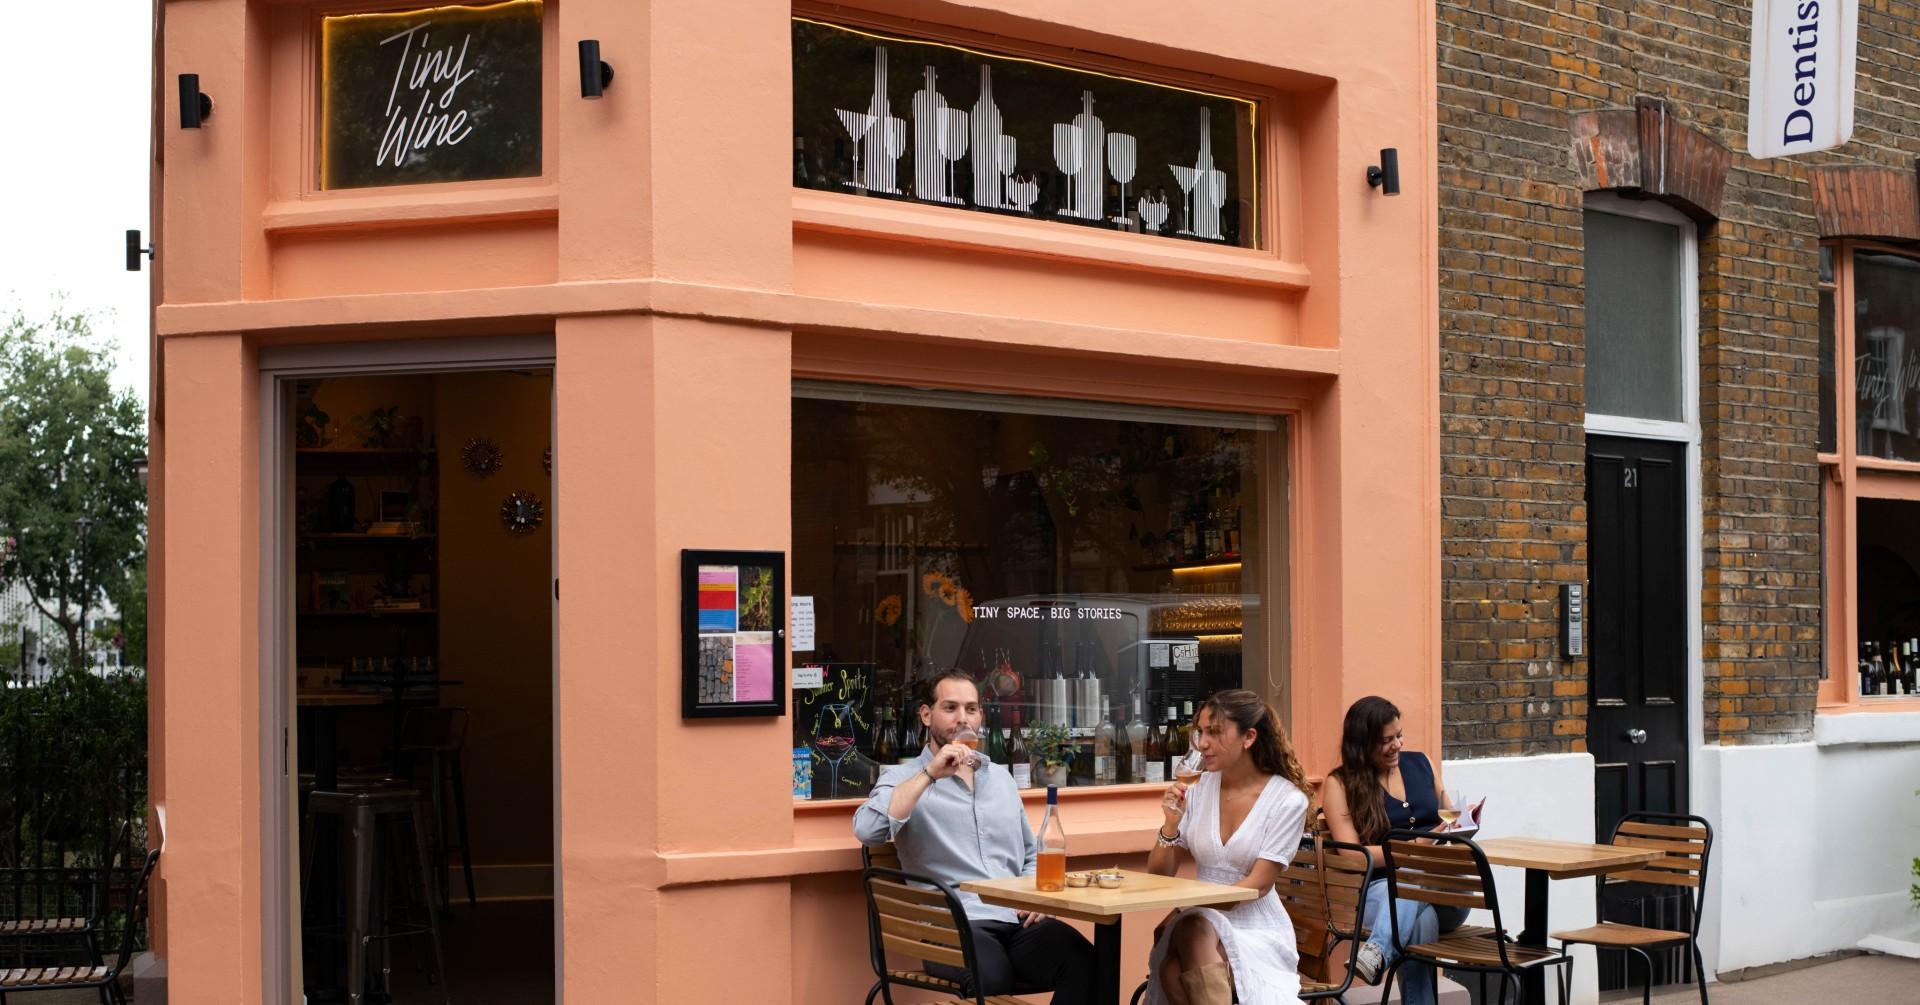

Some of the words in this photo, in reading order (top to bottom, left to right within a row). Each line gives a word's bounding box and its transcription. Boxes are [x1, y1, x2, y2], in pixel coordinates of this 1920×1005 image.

[379, 20, 475, 117] Tiny
[1784, 0, 1819, 147] Dentis
[376, 89, 473, 167] Wine
[1624, 467, 1637, 488] 21
[973, 606, 999, 619] TINY
[1007, 607, 1045, 620] SPACE,
[1051, 607, 1071, 619] BIG
[1078, 607, 1122, 620] STORIES
